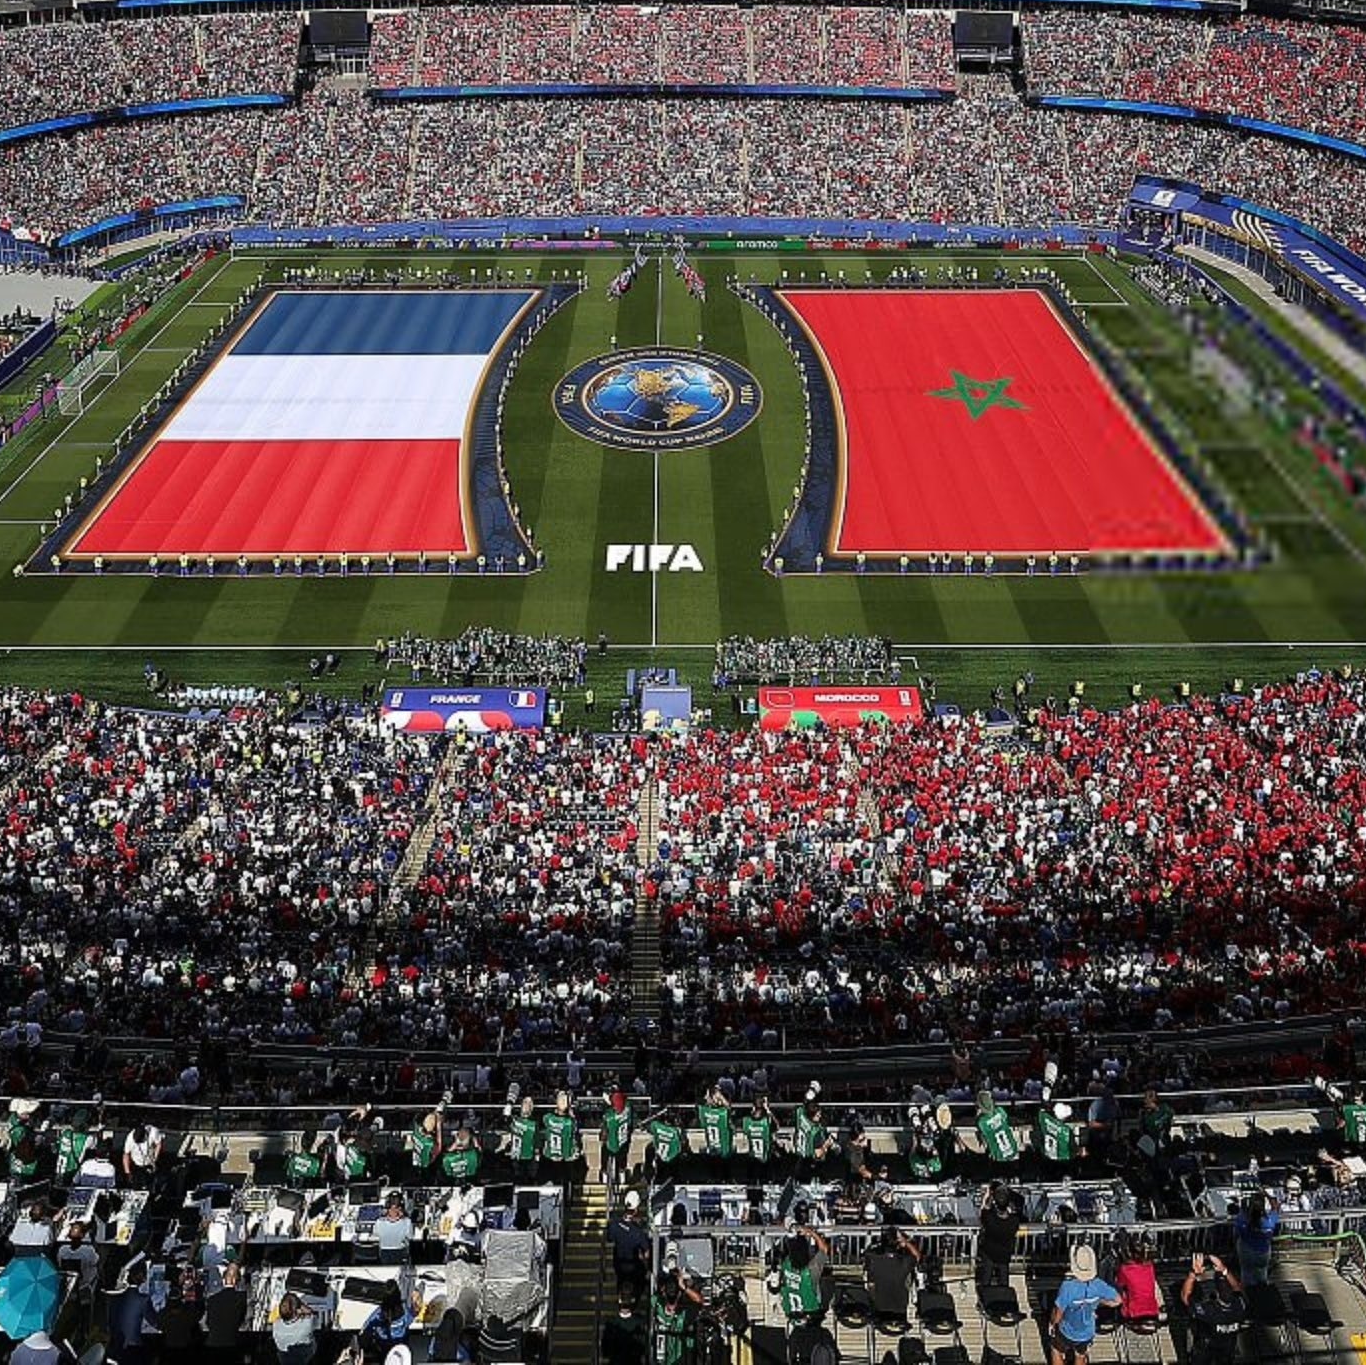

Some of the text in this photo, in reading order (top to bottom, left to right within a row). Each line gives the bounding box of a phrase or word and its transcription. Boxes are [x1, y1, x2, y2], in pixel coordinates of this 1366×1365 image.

[736, 239, 778, 249] aramco
[1291, 248, 1333, 274] FIFA
[612, 435, 657, 446] WORLD
[658, 437, 684, 446] CUP
[606, 544, 704, 572] FIFA
[429, 694, 482, 704] FRANCE
[814, 694, 880, 702] MOROCCO
